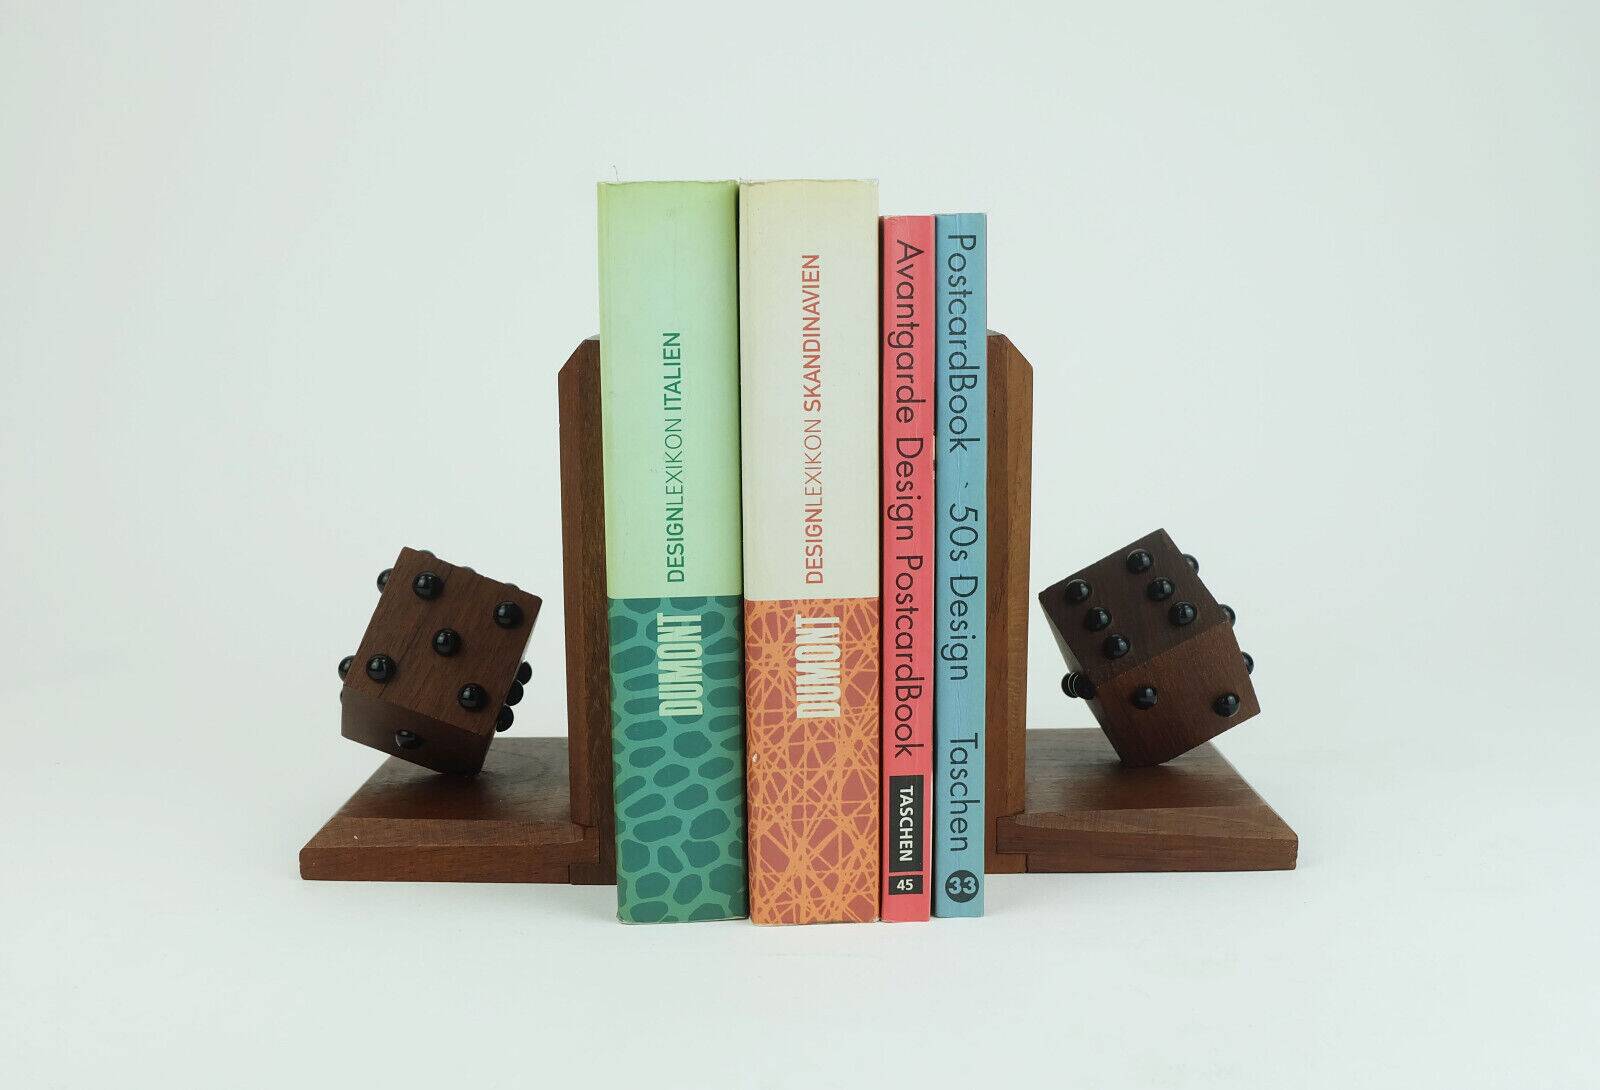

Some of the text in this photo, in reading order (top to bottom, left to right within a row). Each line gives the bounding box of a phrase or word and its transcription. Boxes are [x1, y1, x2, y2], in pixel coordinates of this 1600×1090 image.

[662, 331, 685, 583] DESIGNLEXIKON ITALIEN
[801, 253, 824, 584] DESIGNLEXIKON SKANDINAVIEN
[887, 239, 926, 758] Avantgarde Design PostcardBook
[940, 234, 980, 852] PostcardBook 50s Design Taschen
[656, 612, 704, 717] DUMONT
[794, 614, 841, 719] DUMONT
[899, 785, 914, 862] TASCHEN
[896, 878, 914, 891] 45
[948, 876, 977, 895] 33
